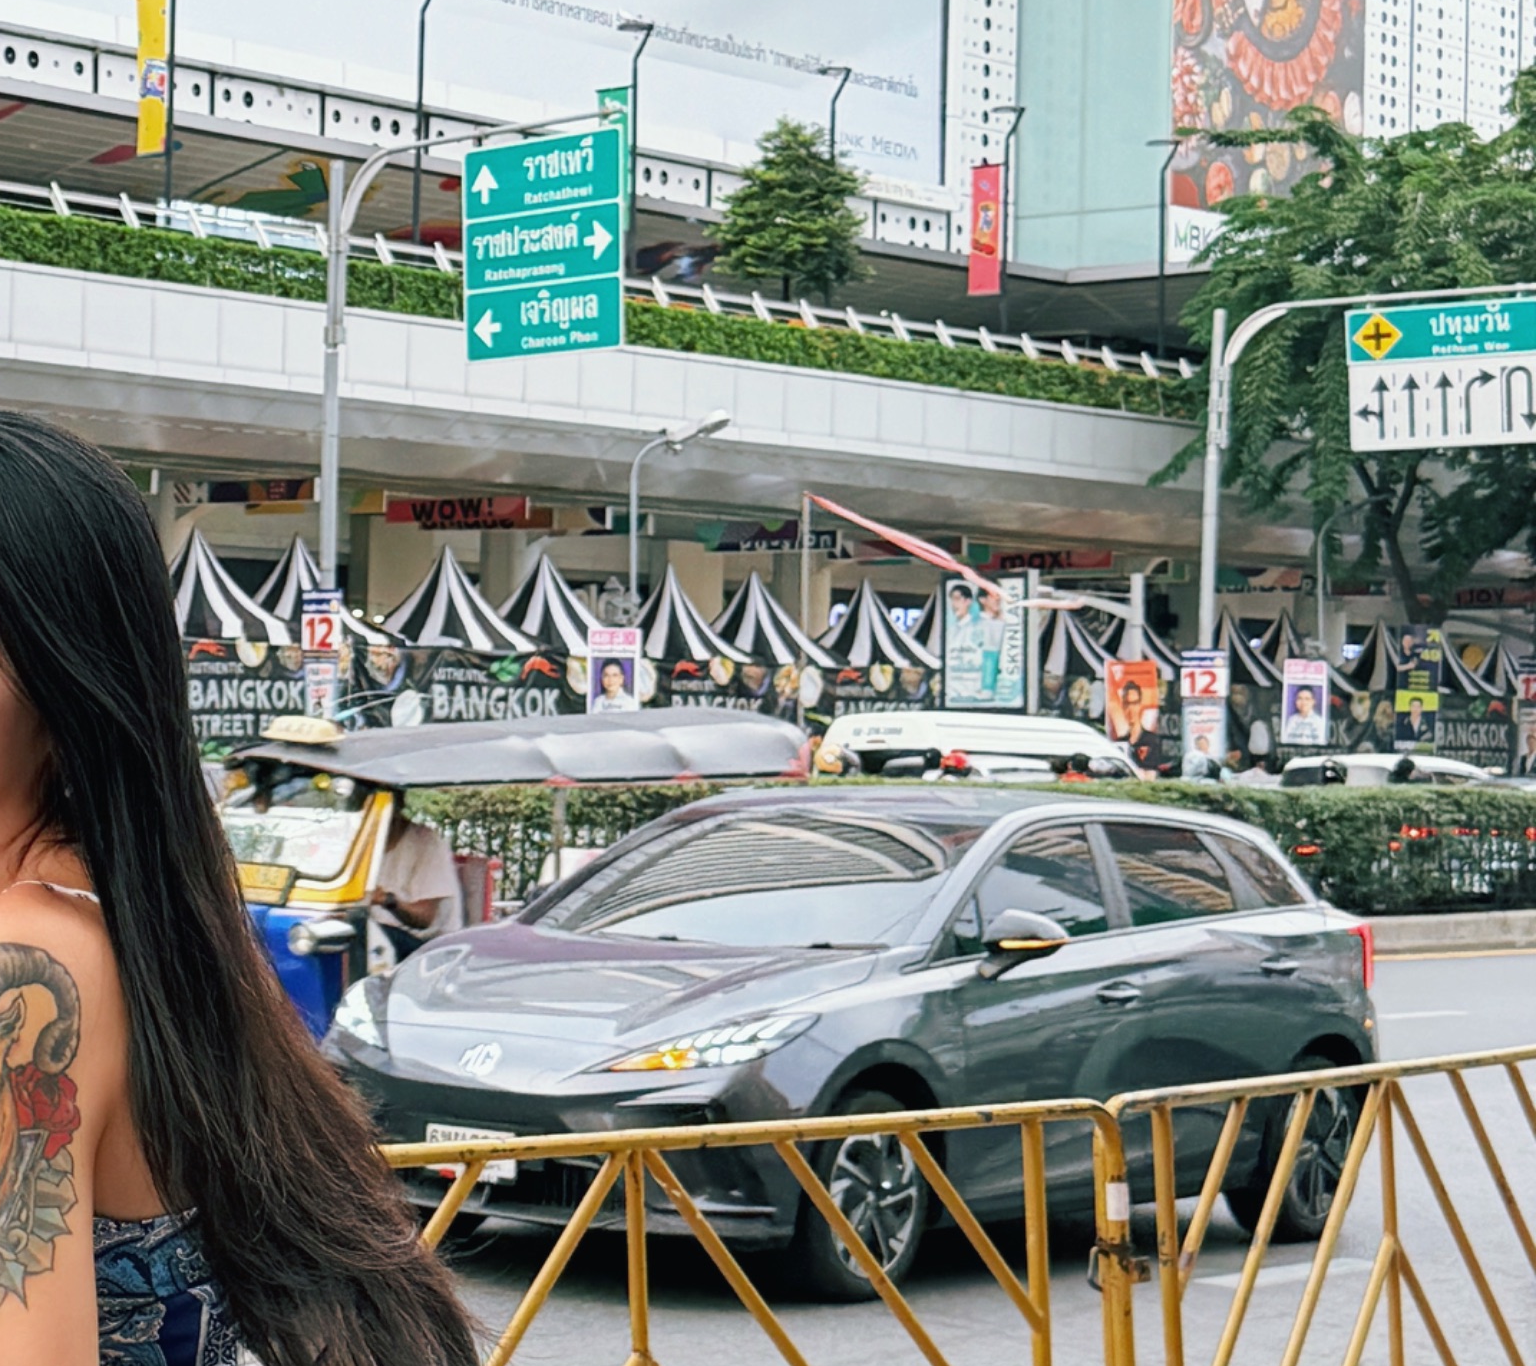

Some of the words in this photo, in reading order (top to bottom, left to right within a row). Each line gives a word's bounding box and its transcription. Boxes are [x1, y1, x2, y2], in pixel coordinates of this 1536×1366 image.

[523, 136, 594, 181] ราชเทวี
[871, 134, 918, 161] MEDIA
[524, 185, 593, 204] Ratchathewi
[472, 212, 581, 260] ราชประสงค์
[485, 263, 565, 282] Ratchaprasong
[520, 289, 599, 329] เจริญผล
[1429, 303, 1511, 344] ปทุมวัน
[521, 335, 566, 350] Charoen
[570, 331, 599, 345] Phon
[411, 496, 494, 522] WOW!
[306, 615, 334, 650] 12
[189, 679, 304, 710] BANGKOK
[1183, 670, 1218, 695] 12
[432, 684, 560, 720] BANGKOK
[1437, 722, 1509, 749] BANGKOK
